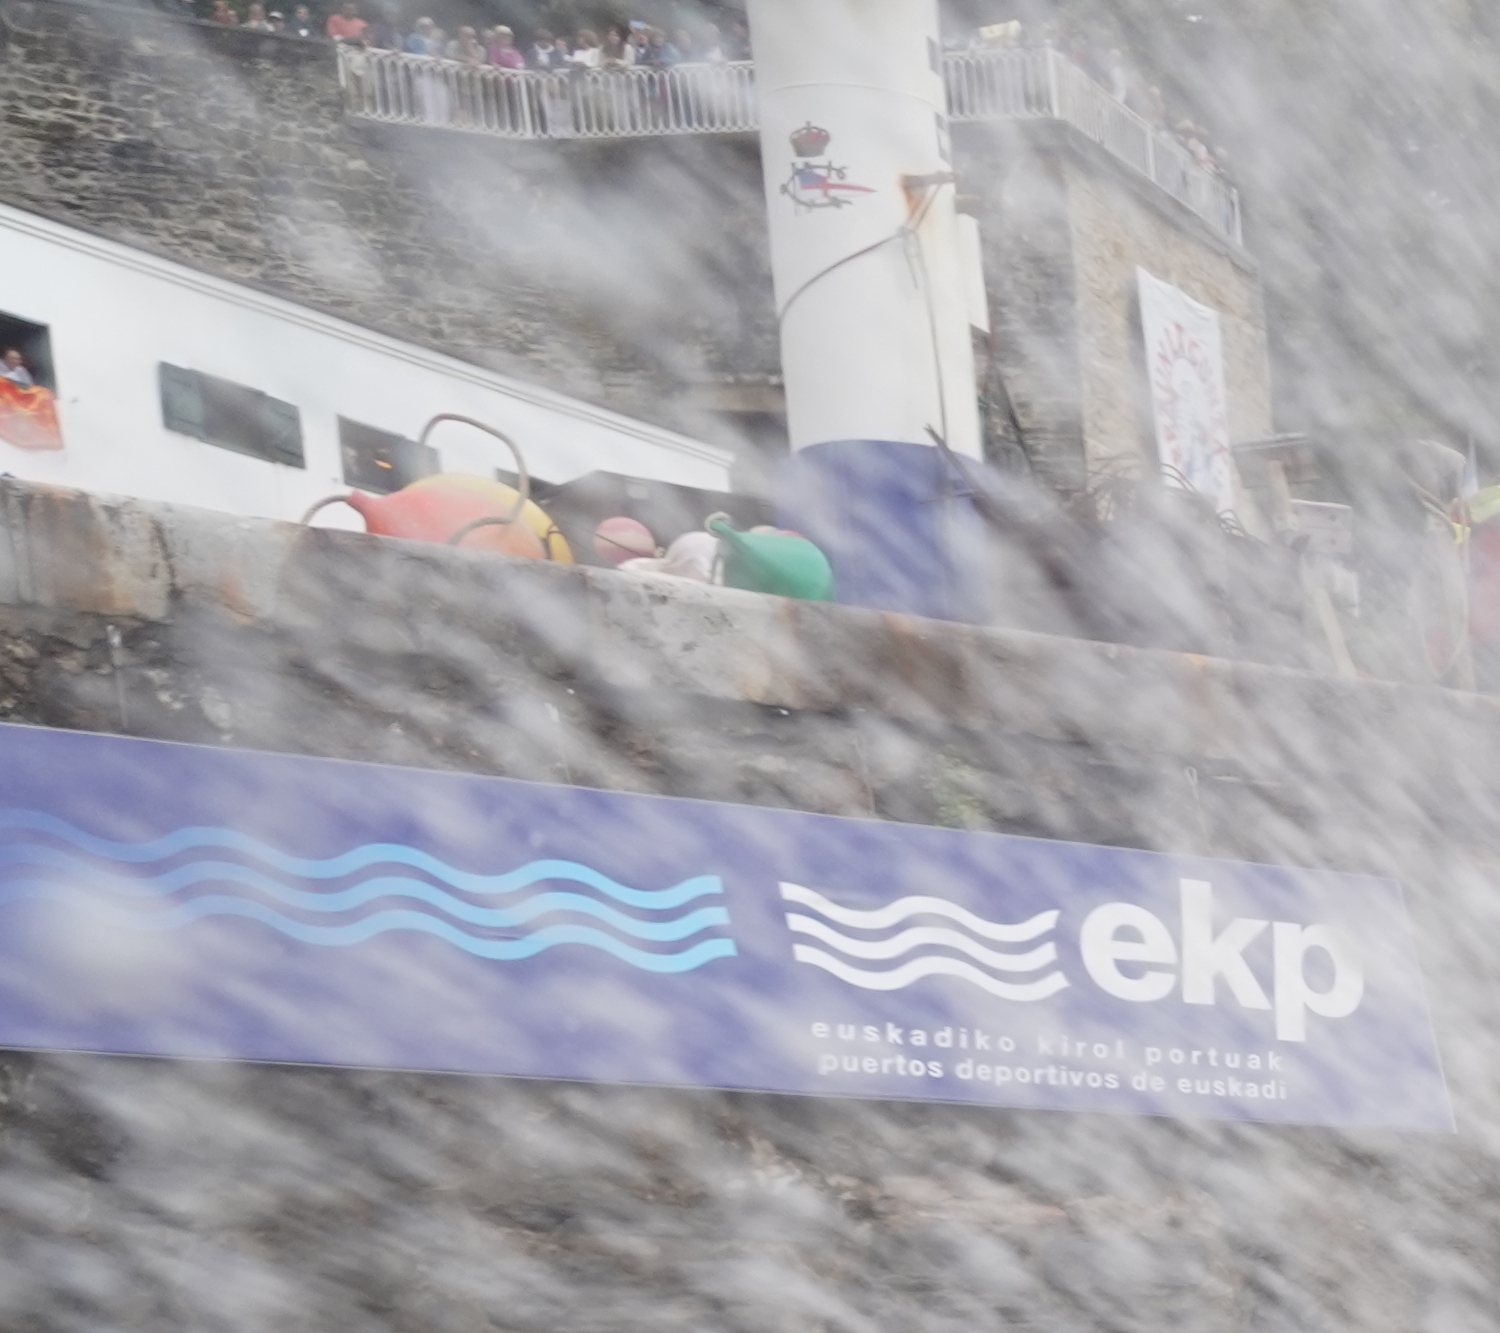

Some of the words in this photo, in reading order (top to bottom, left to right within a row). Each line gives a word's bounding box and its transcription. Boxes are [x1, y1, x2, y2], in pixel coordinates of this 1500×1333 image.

[1079, 877, 1365, 1042] ekp
[811, 1020, 1016, 1053] euskadiko
[1037, 1031, 1127, 1060] kirol
[1144, 1042, 1284, 1071] portuak
[817, 1052, 945, 1078] puertos
[955, 1058, 1119, 1089] deportivos
[1132, 1069, 1166, 1092] de
[1177, 1074, 1288, 1100] euskadi
